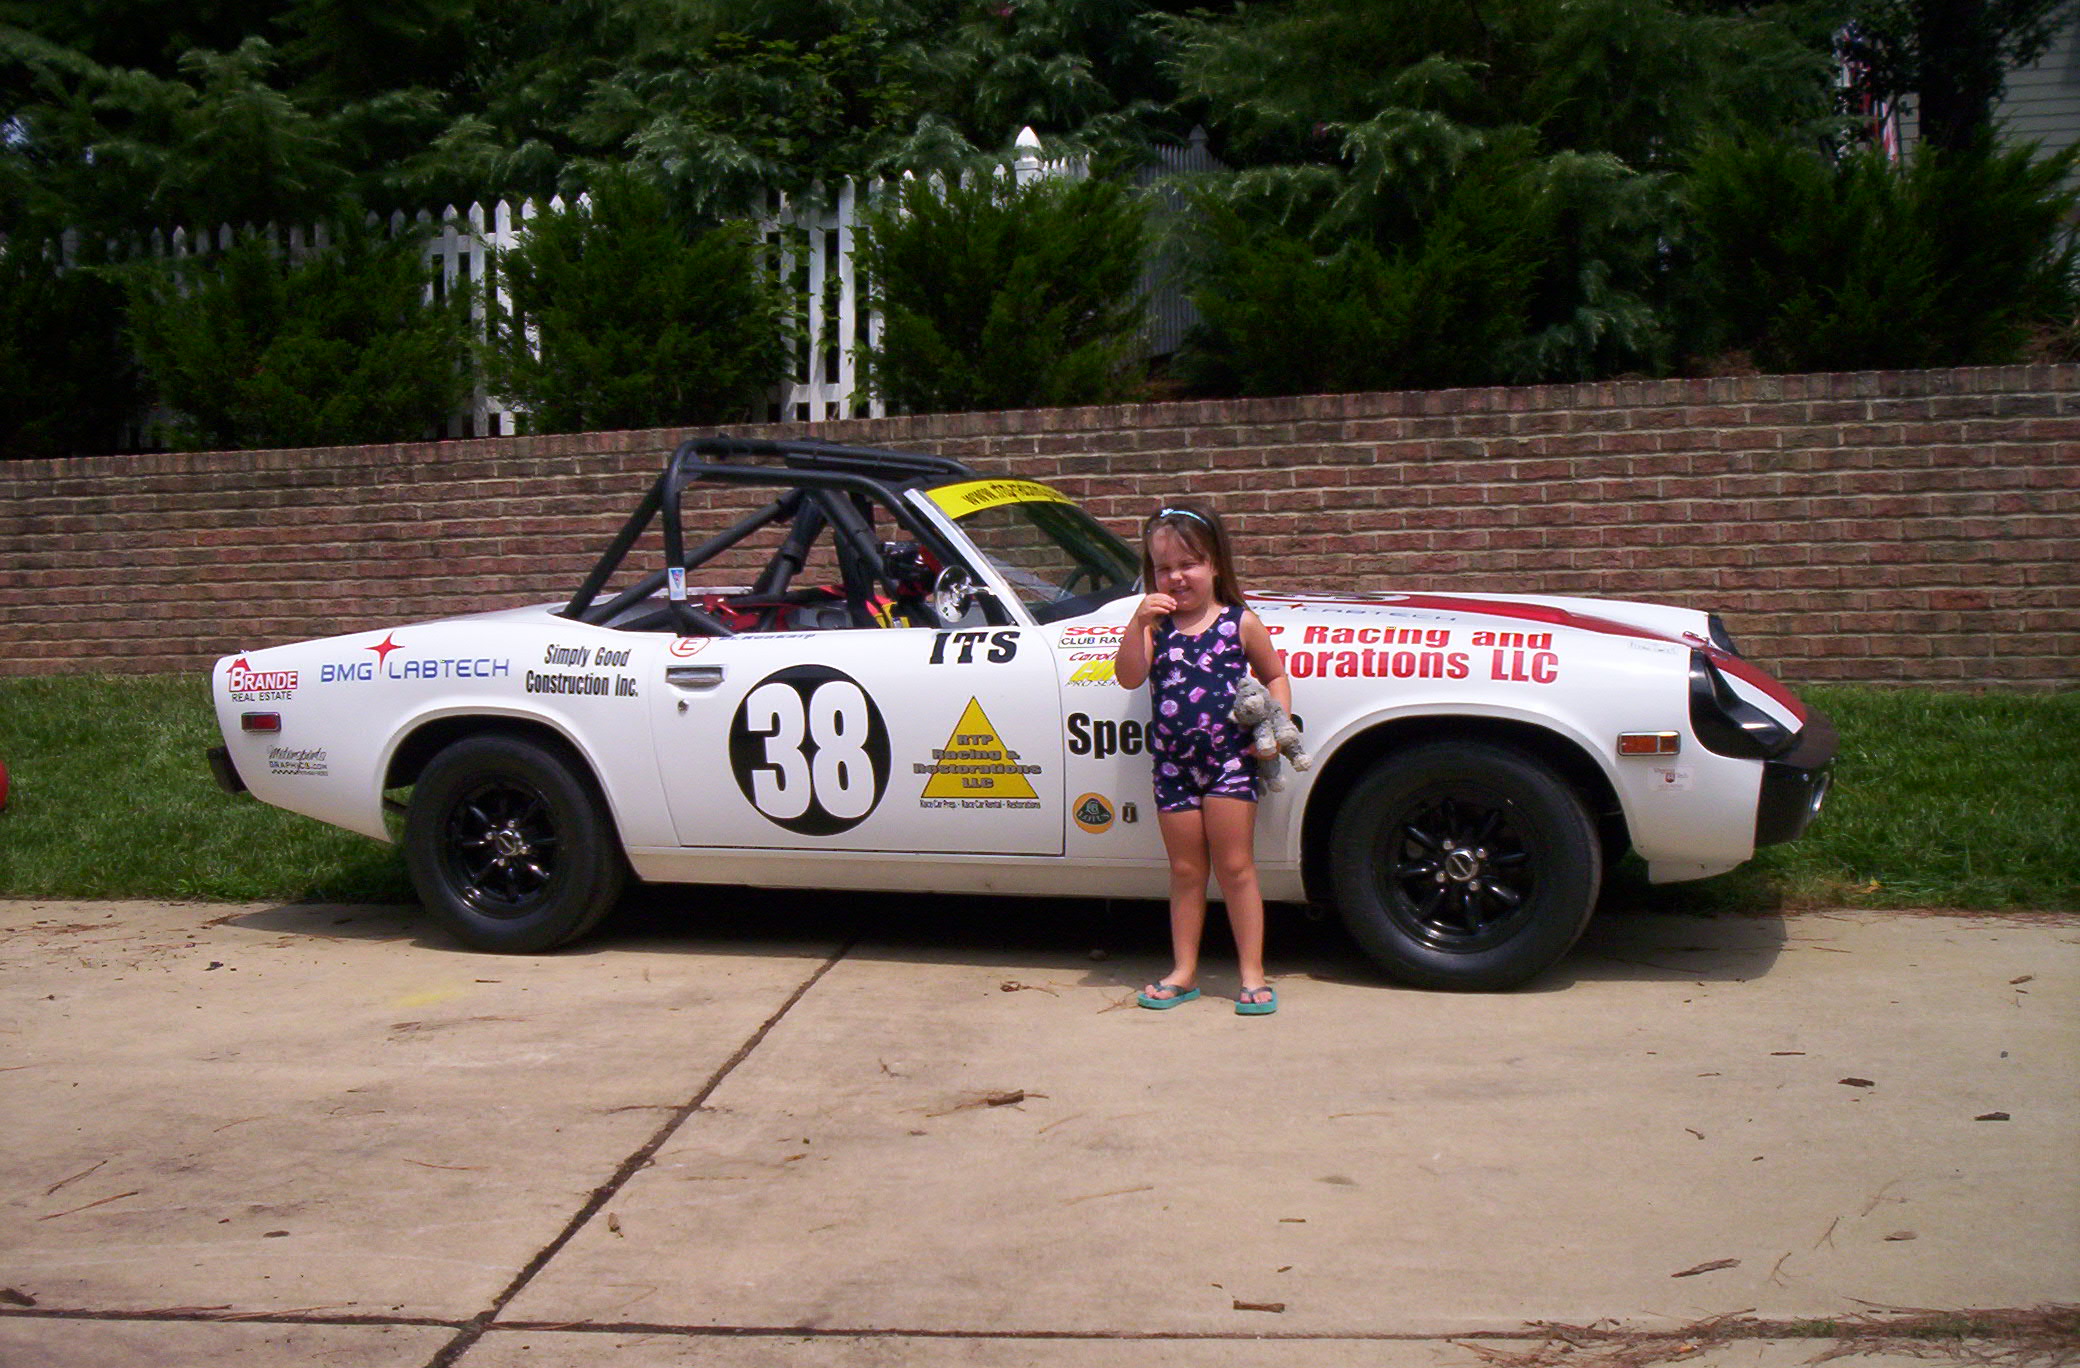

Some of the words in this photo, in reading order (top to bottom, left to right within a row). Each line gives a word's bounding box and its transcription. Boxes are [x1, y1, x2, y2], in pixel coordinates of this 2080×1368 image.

[1065, 626, 1127, 636] SCC
[1303, 626, 1451, 649] Racing
[1472, 631, 1553, 650] and
[678, 638, 698, 651] E
[929, 631, 1021, 664] ITS
[1061, 637, 1095, 645] CLUB
[544, 643, 591, 667] Simply
[595, 647, 632, 667] Good
[320, 662, 373, 682] BMG
[388, 658, 510, 679] LABTECH
[1490, 649, 1559, 684] LLC
[230, 667, 298, 692] BRANDE
[526, 669, 609, 696] Construction
[615, 673, 639, 697] Inc.
[231, 692, 256, 702] REAL
[259, 691, 292, 701] ESTATE
[957, 734, 993, 746] RTP
[747, 681, 876, 819] 38
[932, 749, 1002, 760] Racing
[913, 763, 1042, 775] Restorations
[961, 777, 994, 789] LLC
